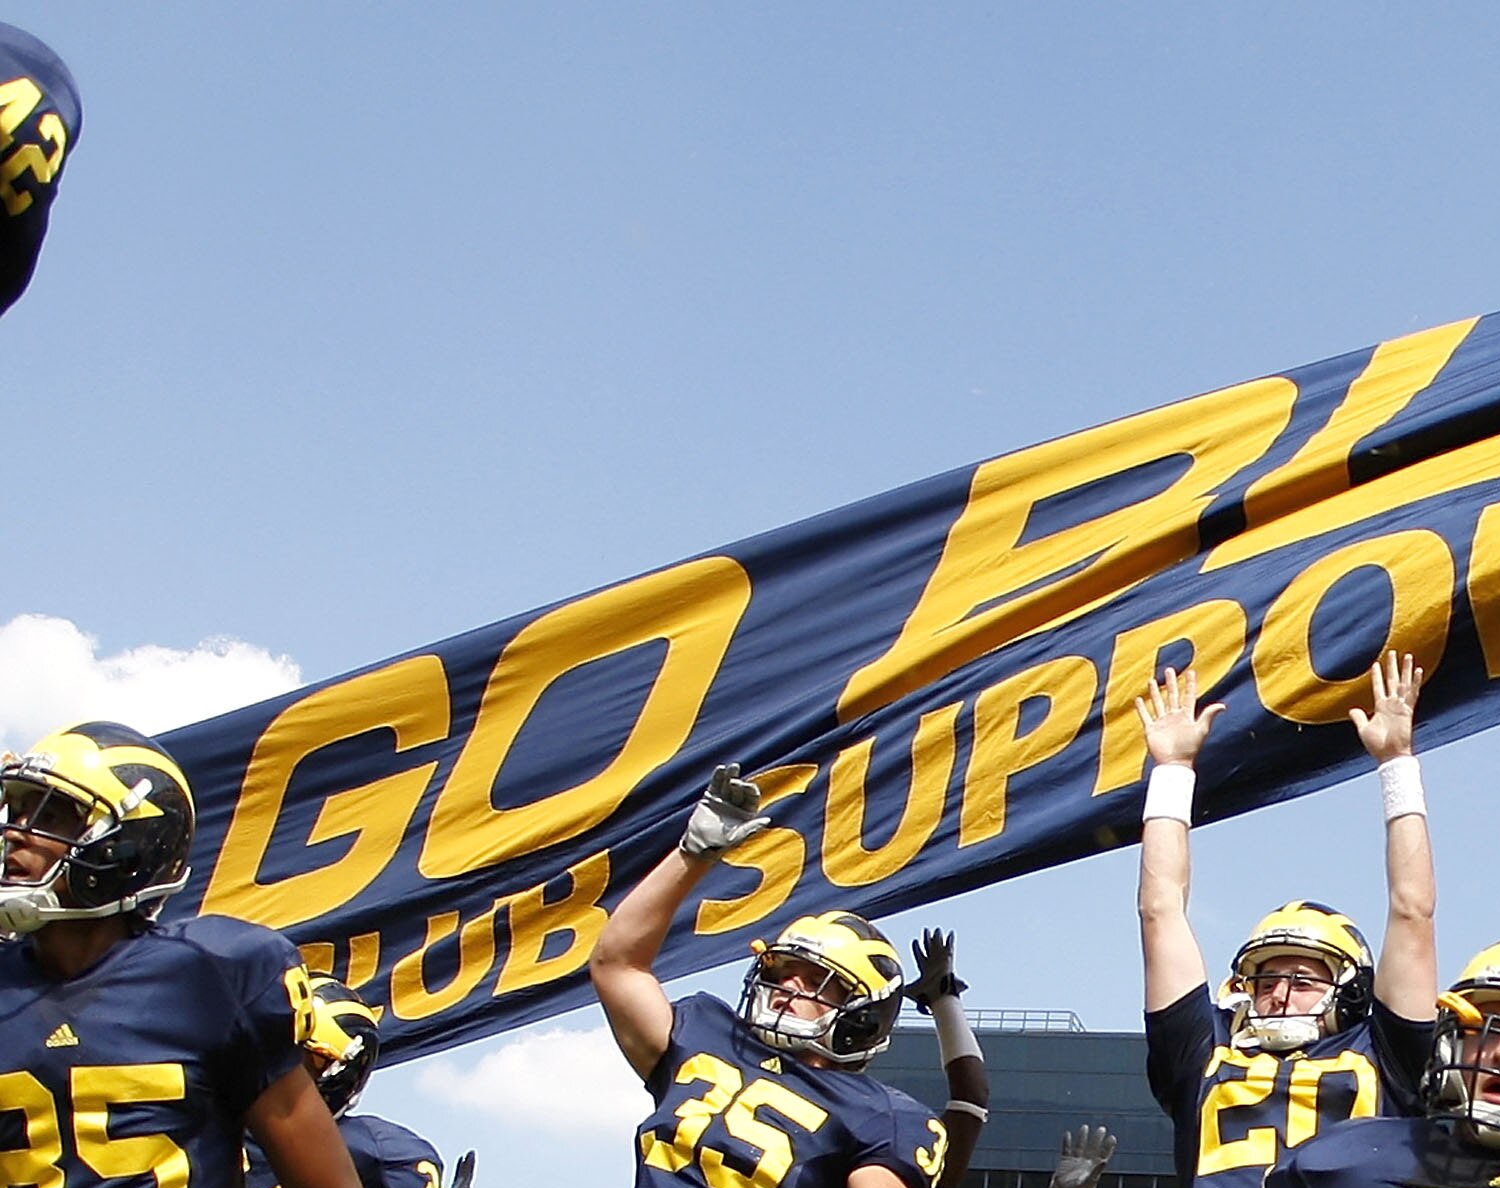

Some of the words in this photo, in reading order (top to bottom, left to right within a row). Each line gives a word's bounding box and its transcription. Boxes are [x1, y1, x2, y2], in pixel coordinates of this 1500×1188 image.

[200, 555, 751, 930] GO
[296, 849, 611, 1021] UB
[1197, 1045, 1379, 1177] 20
